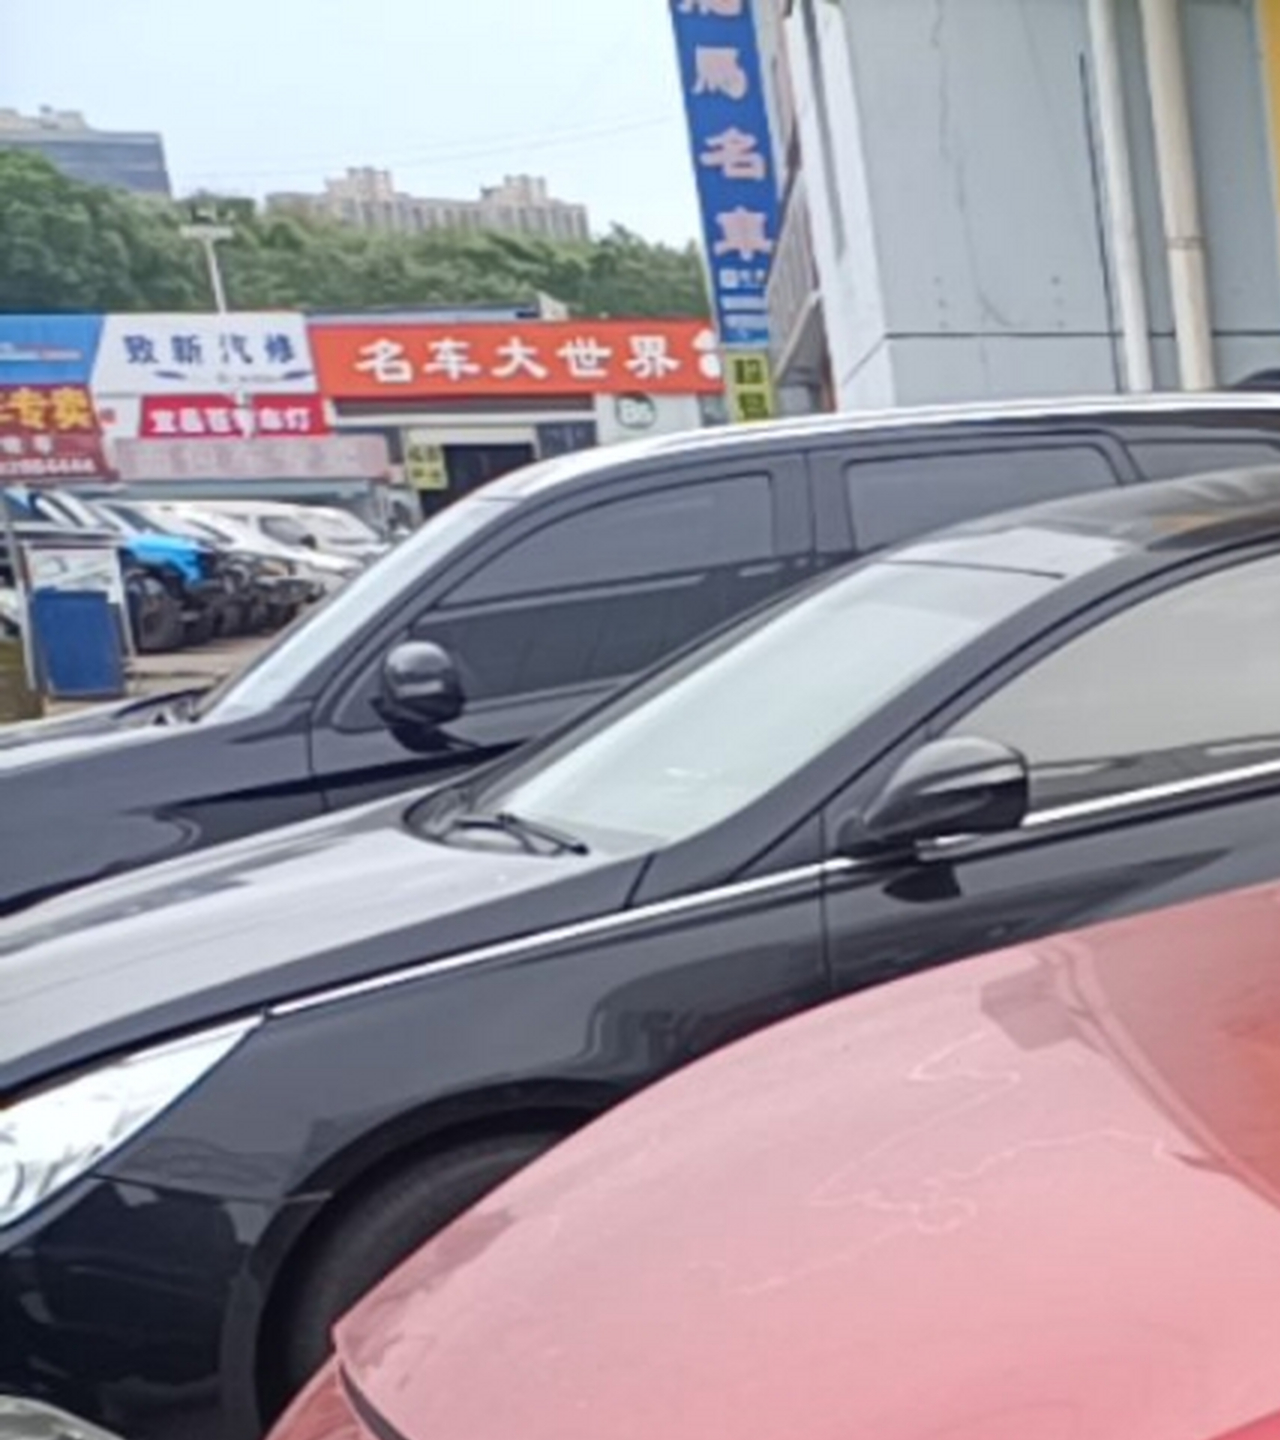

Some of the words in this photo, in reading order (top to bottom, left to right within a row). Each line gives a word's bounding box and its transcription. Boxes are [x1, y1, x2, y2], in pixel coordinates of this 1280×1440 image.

[124, 334, 298, 365] 致新汽修
[355, 335, 681, 383] 名车大世界
